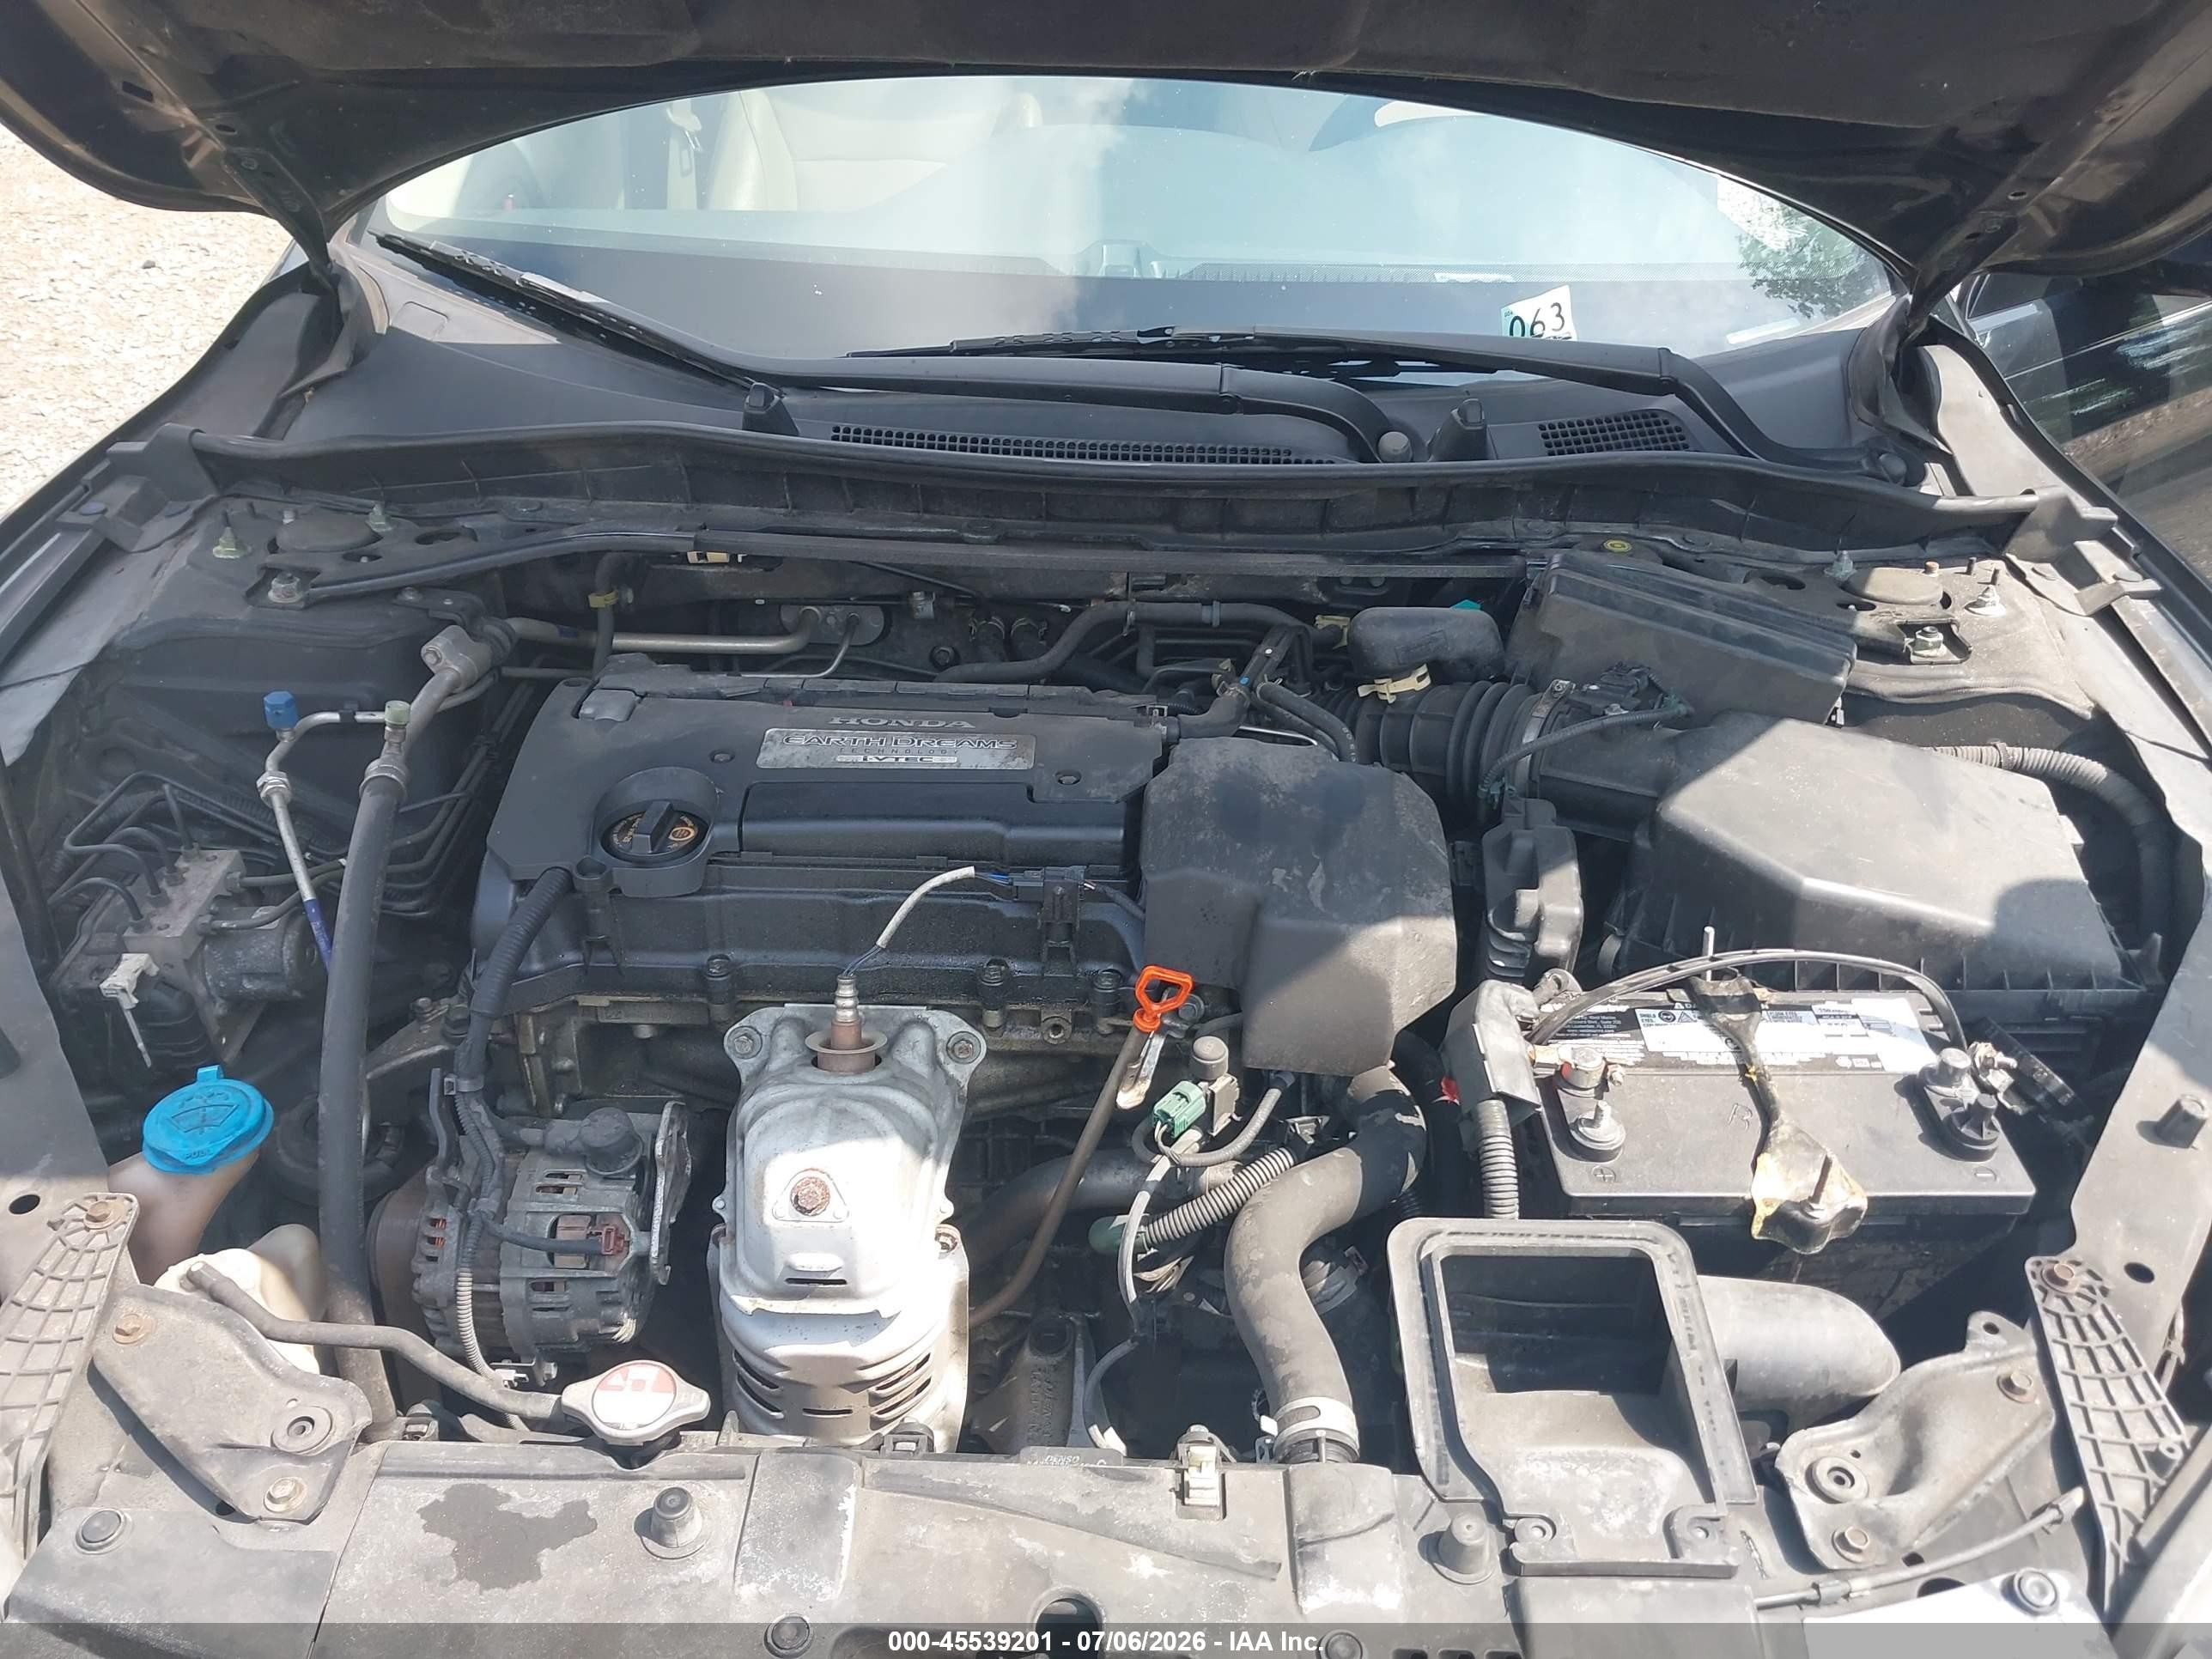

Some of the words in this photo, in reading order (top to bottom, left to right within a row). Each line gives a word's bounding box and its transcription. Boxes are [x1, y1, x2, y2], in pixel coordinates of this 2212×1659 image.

[828, 716, 975, 728] HONDA
[783, 735, 886, 748] EARTH
[891, 736, 1018, 750] DREAMS
[1045, 1455, 1080, 1464] DENSO
